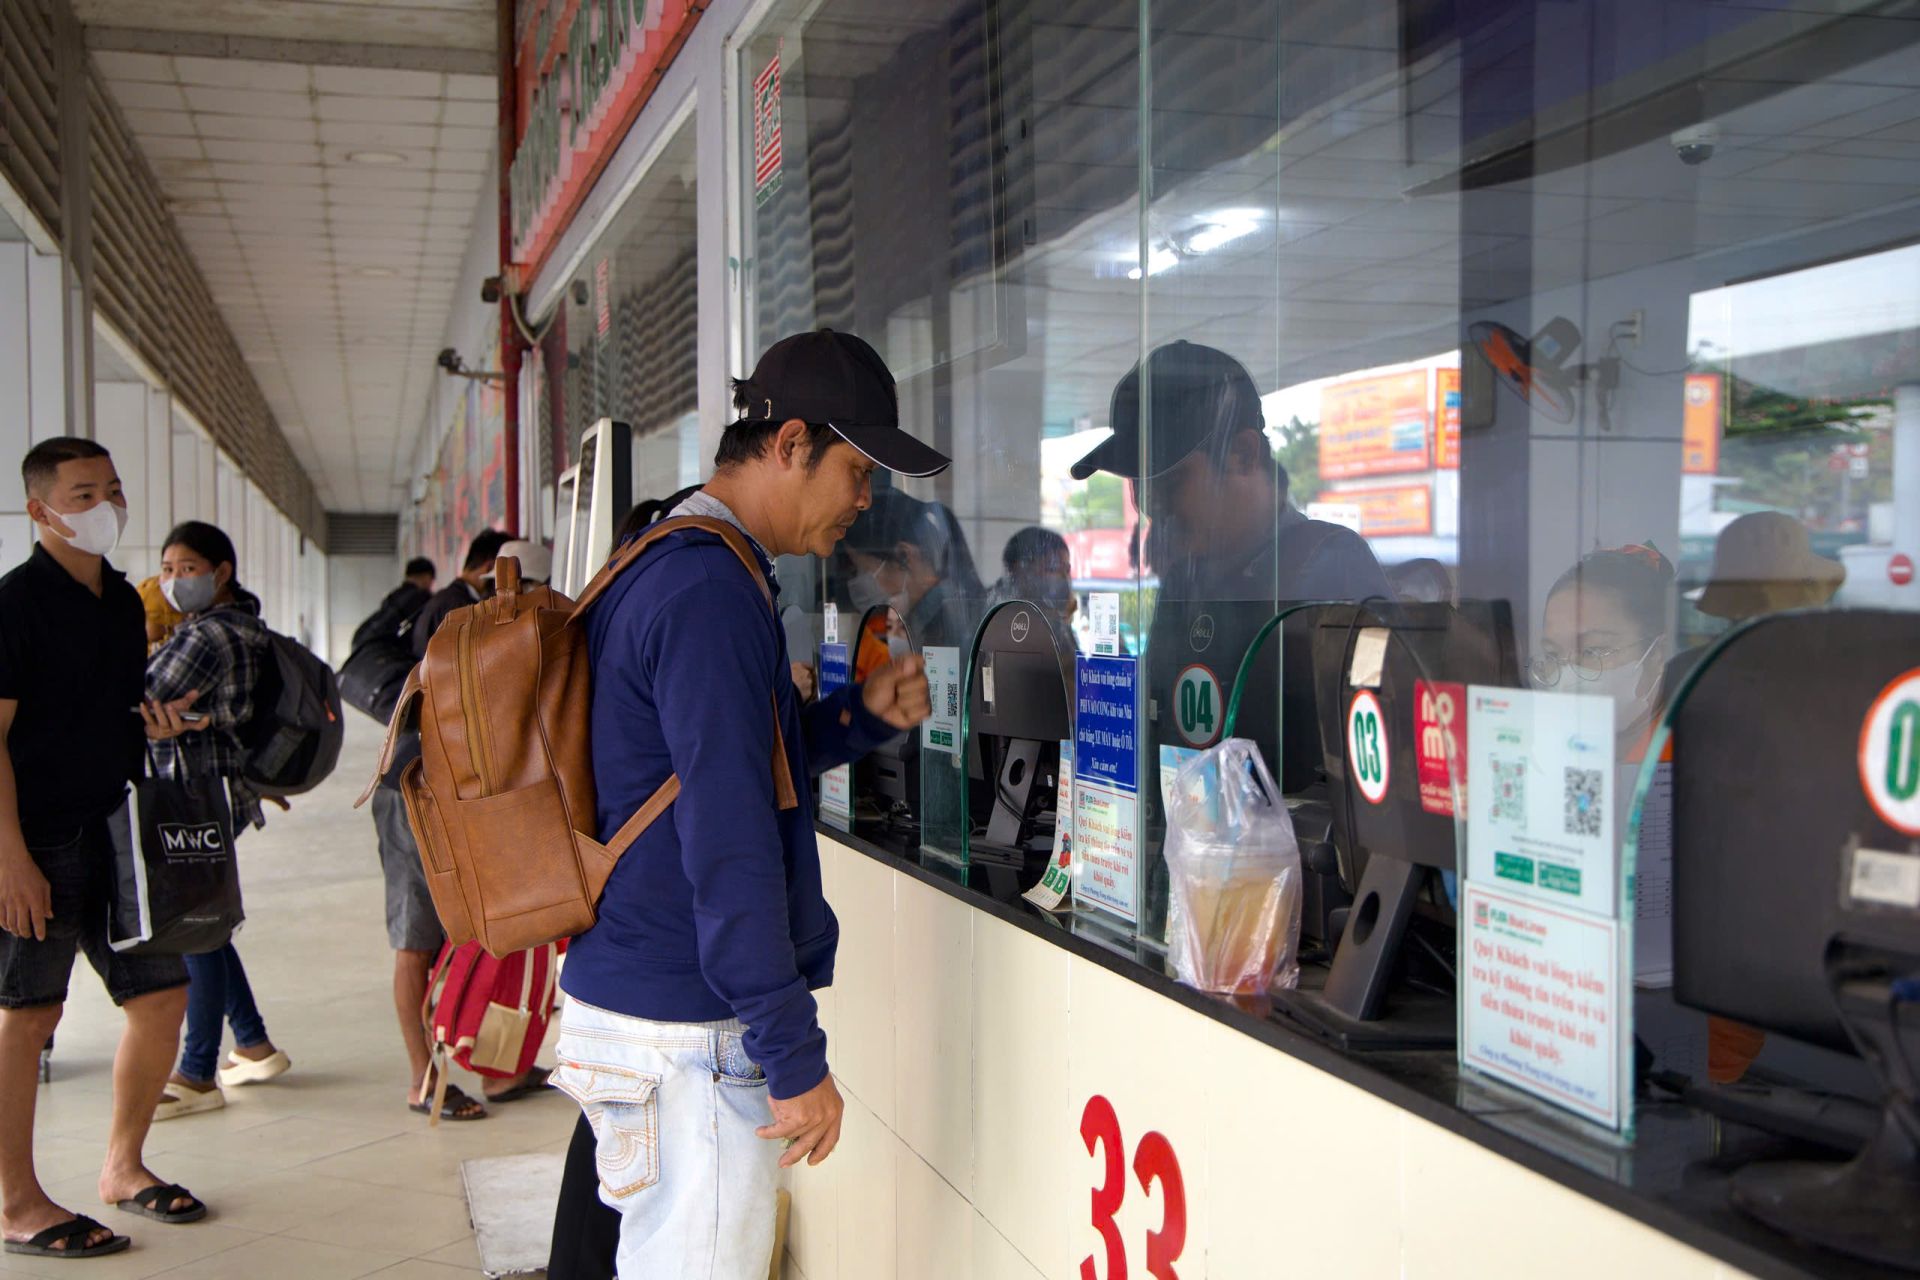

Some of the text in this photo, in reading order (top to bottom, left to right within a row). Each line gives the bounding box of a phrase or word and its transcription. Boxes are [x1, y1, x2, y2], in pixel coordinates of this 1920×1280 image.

[1013, 622, 1027, 632] DELL
[1089, 669, 1100, 684] Khách
[1181, 679, 1213, 733] 04
[1355, 711, 1381, 783] 03
[164, 829, 220, 850] MWC
[1474, 938, 1494, 961] Quý
[1497, 944, 1530, 970] Khách
